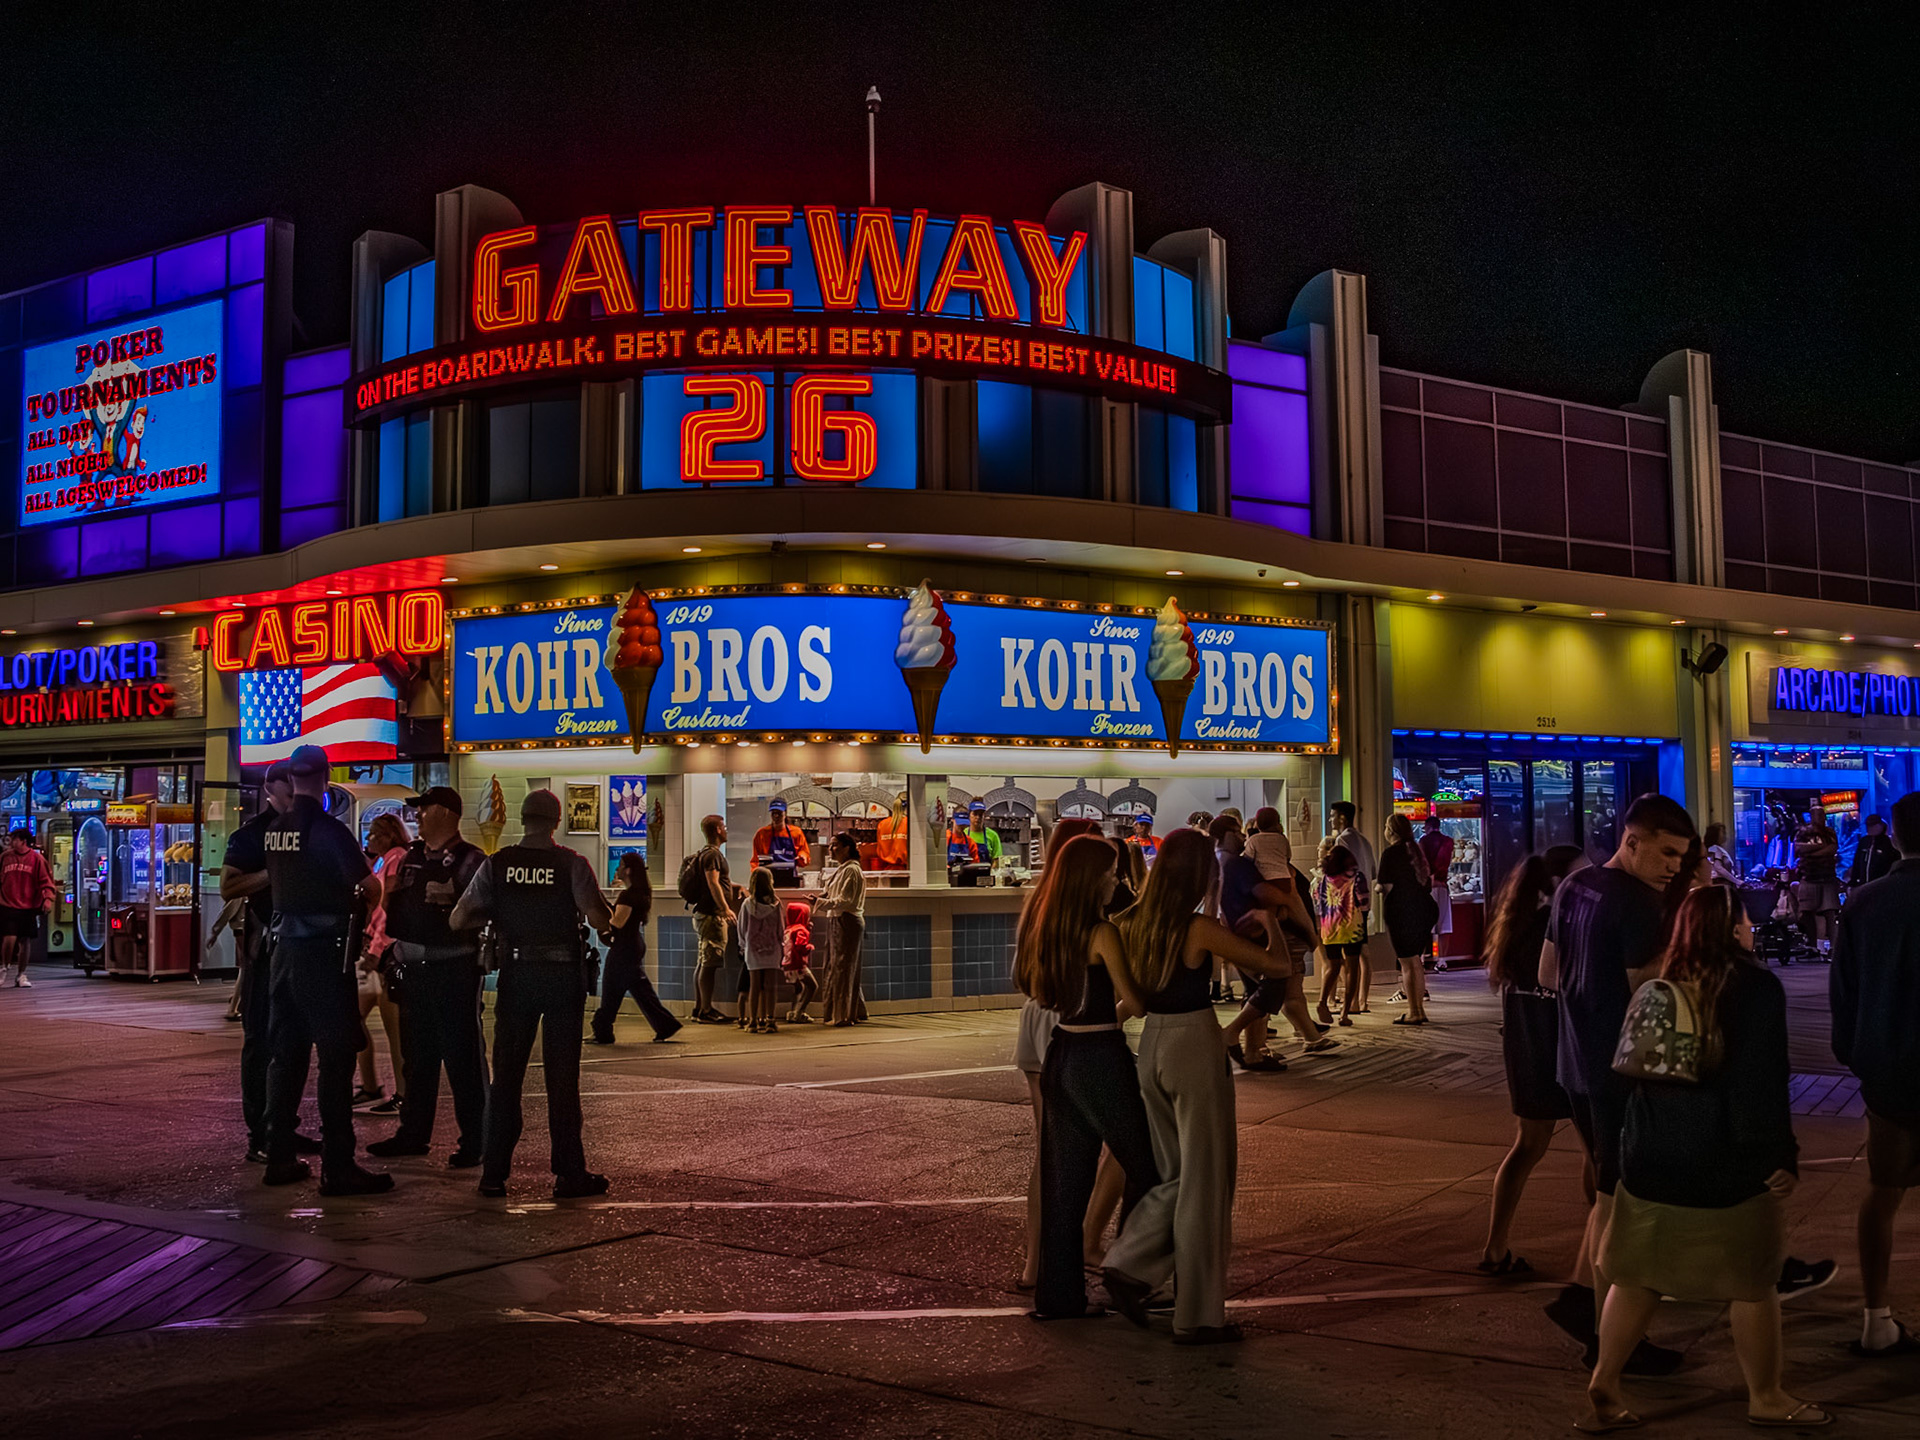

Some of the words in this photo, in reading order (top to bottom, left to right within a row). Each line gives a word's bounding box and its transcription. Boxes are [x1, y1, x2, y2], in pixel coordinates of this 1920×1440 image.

[473, 205, 1088, 333] GATEWAY
[75, 326, 164, 373] POKER
[357, 382, 381, 410] ON
[382, 366, 420, 398] THE
[423, 336, 604, 391] BOARDWALK.
[615, 330, 686, 362] BEST
[696, 327, 818, 356] GAMES!
[828, 328, 903, 357] BEST
[912, 330, 1021, 367] PRIZES!
[1029, 341, 1089, 376] BEST
[1095, 350, 1178, 395] VALUE!
[27, 353, 217, 422] TOURNAMENTS
[27, 430, 56, 451] ALL
[59, 420, 94, 444] DAY
[680, 374, 877, 482] 26
[25, 463, 54, 484] ALL
[56, 451, 109, 476] NIGHT
[25, 493, 53, 513] ALL
[55, 484, 97, 507] AGES
[97, 462, 207, 501] WELCOMED!
[213, 590, 444, 673] CASINO
[554, 611, 604, 636] Since
[666, 604, 714, 626] 1919
[1089, 616, 1140, 639] Since
[1197, 628, 1235, 646] 1919
[474, 638, 604, 715] KOHR
[671, 625, 833, 704] BROS
[1000, 637, 1140, 713] KOHR
[1202, 649, 1314, 720] BROS
[0, 683, 167, 725] URNAMENTS
[555, 712, 618, 735] Frozen
[662, 705, 751, 730] Custard
[1537, 716, 1557, 728] 2516
[1090, 713, 1153, 736] Frozen
[1195, 718, 1261, 740] Custard
[13, 820, 34, 828] AT
[264, 831, 300, 851] POLICE
[506, 866, 554, 885] POLICE
